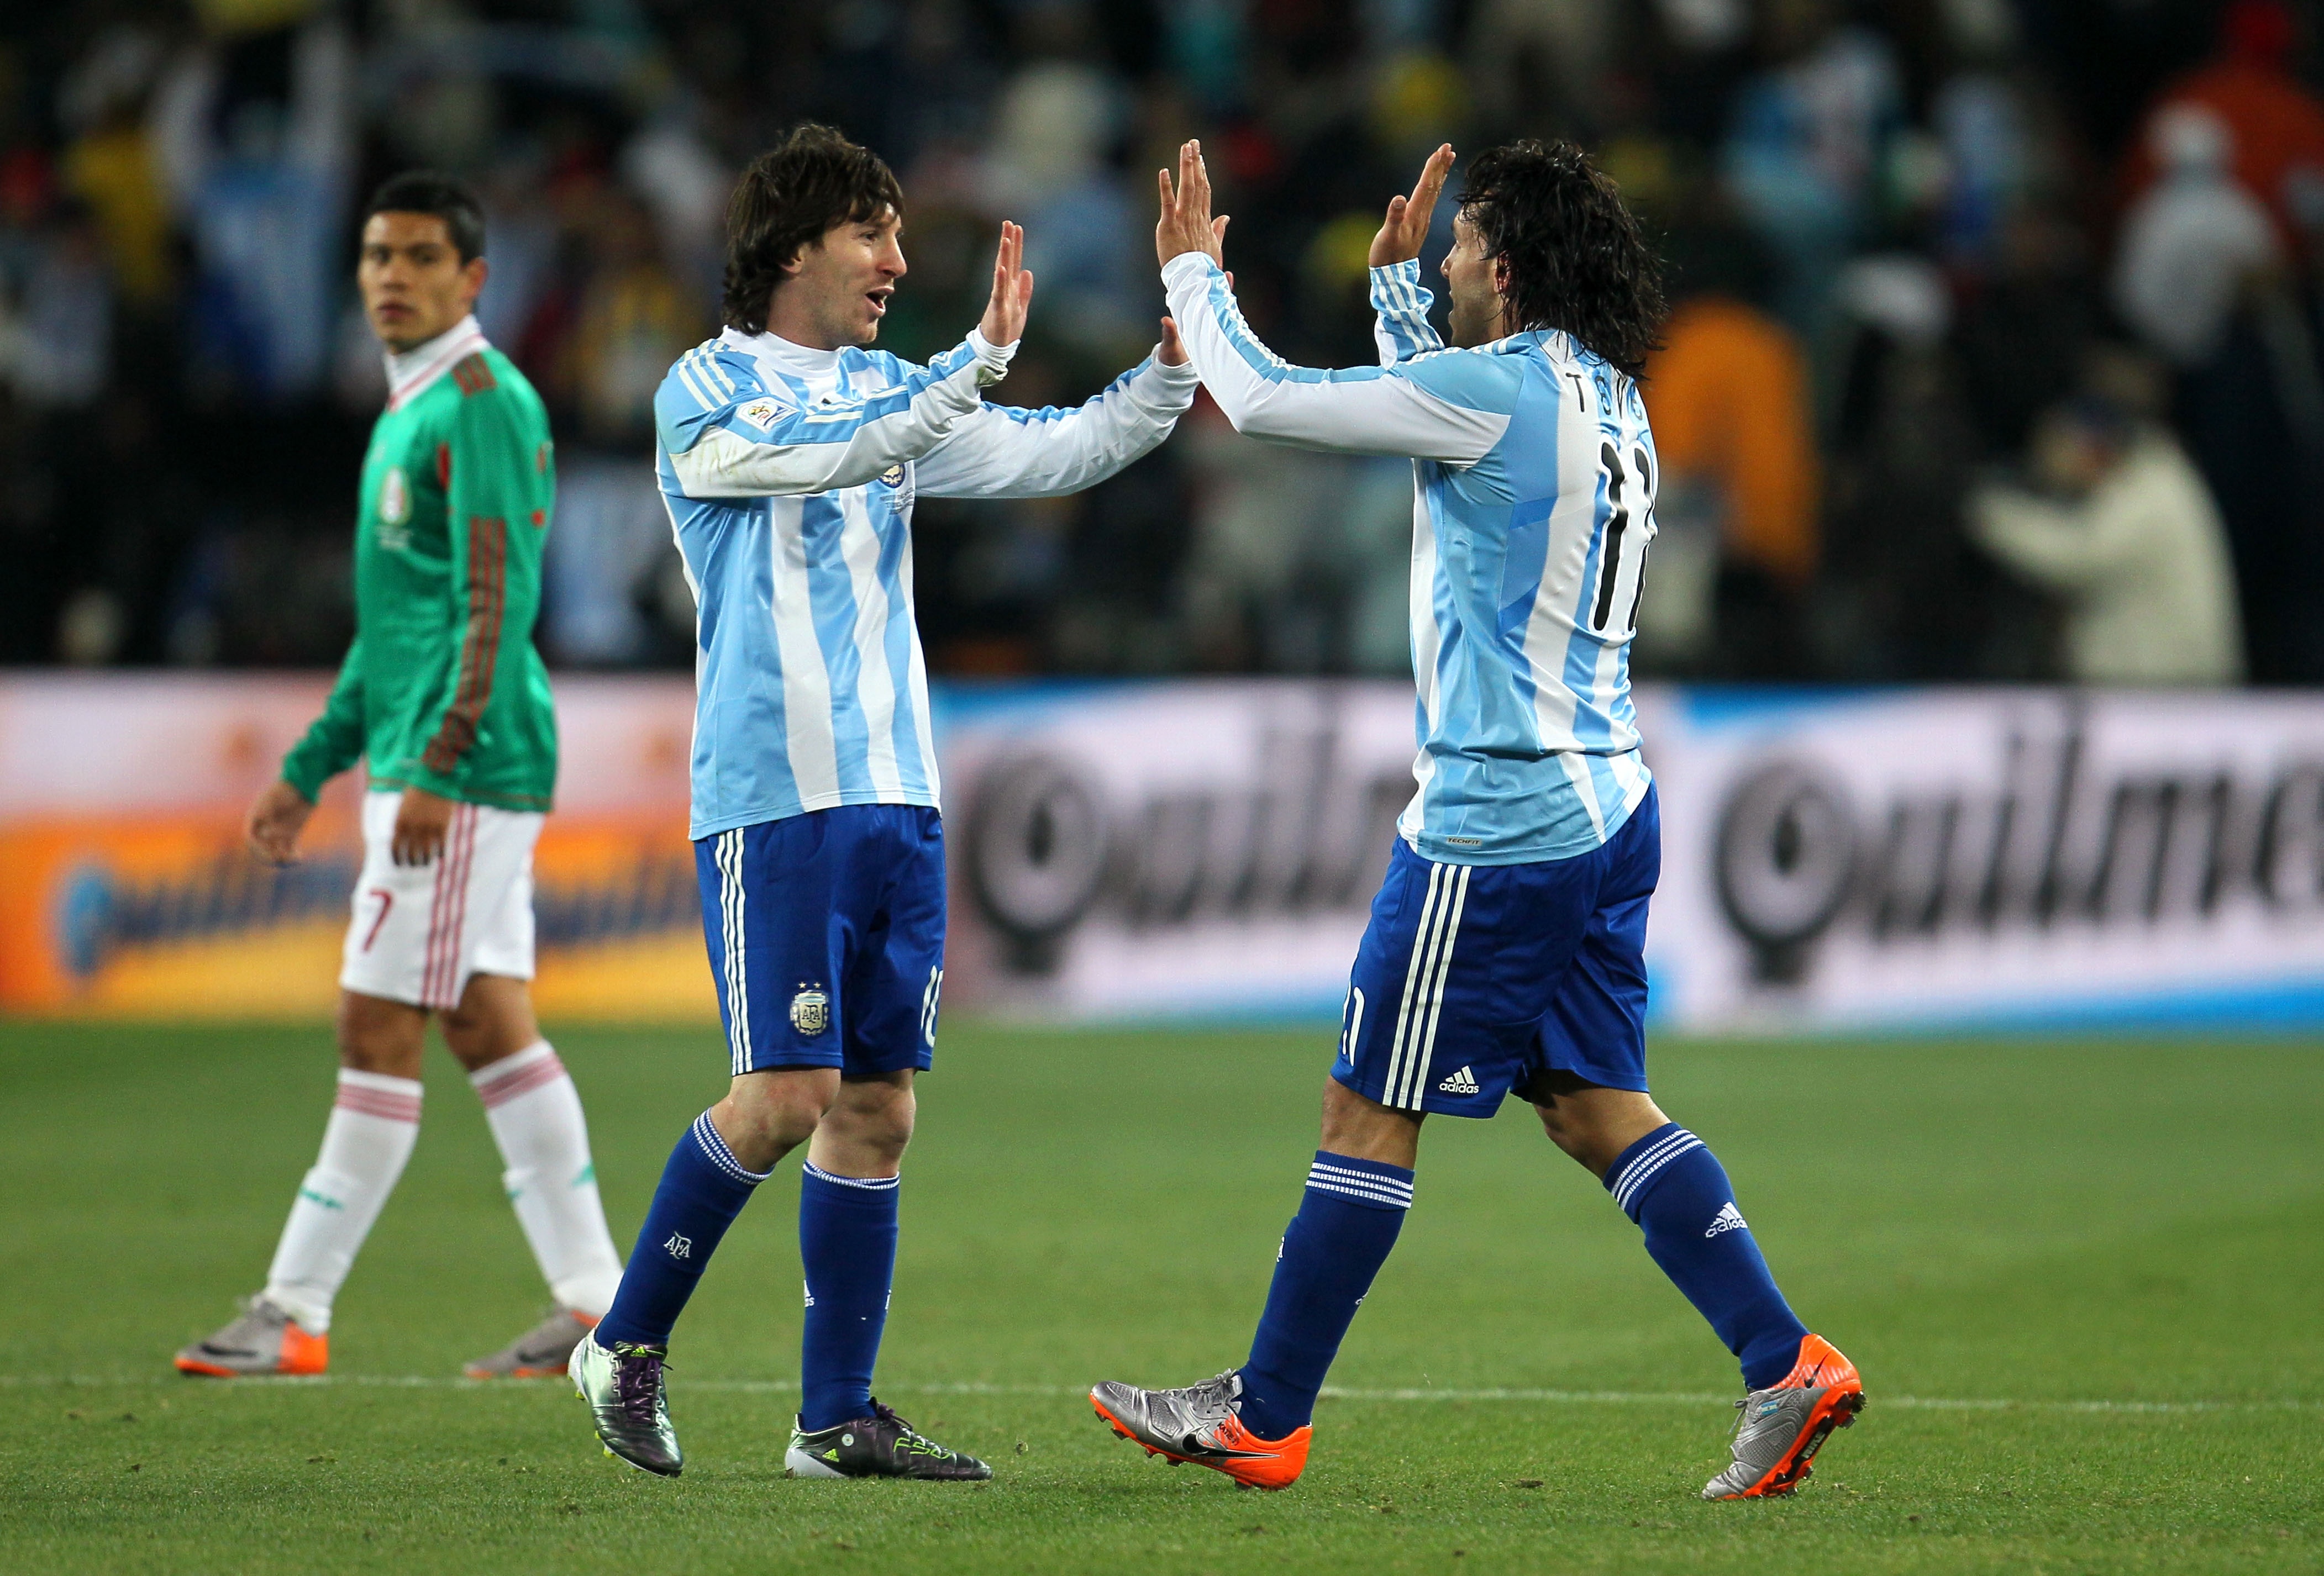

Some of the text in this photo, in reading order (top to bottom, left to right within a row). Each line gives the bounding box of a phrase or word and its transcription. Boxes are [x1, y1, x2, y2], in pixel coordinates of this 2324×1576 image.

[1590, 440, 1655, 633] 11
[362, 888, 392, 952] 7
[1439, 1082, 1480, 1094] adidas
[663, 1230, 692, 1259] AFA
